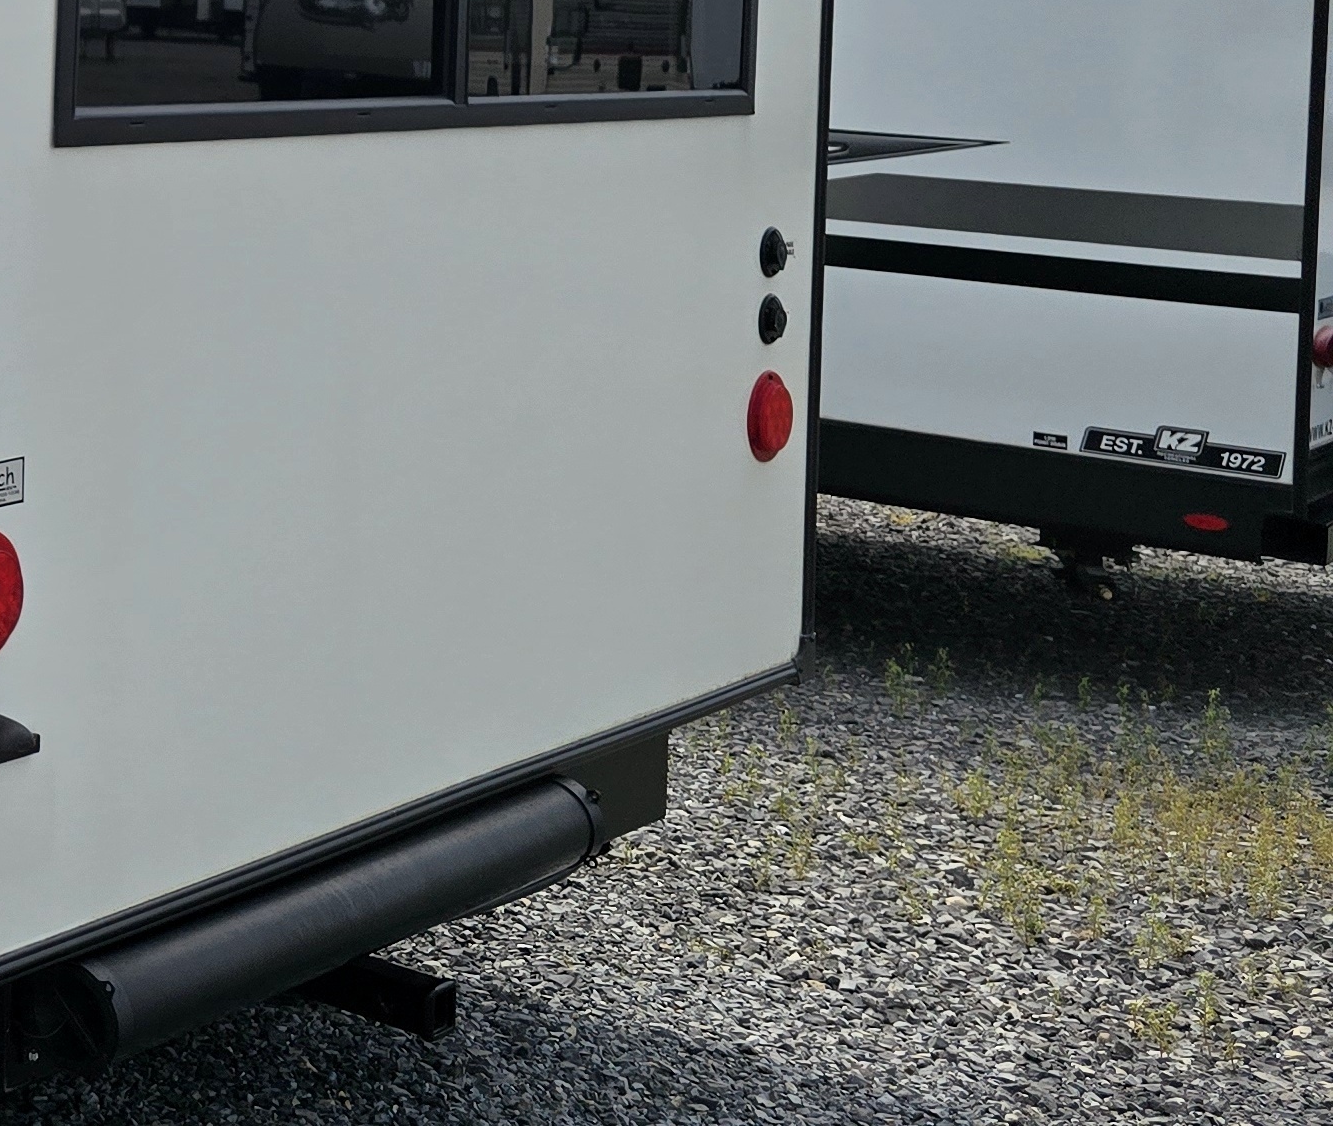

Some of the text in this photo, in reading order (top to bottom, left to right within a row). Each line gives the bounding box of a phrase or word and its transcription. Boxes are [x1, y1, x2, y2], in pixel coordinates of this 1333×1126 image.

[1099, 434, 1144, 456] EST.
[1158, 429, 1202, 453] KZ
[1220, 451, 1266, 473] 1972
